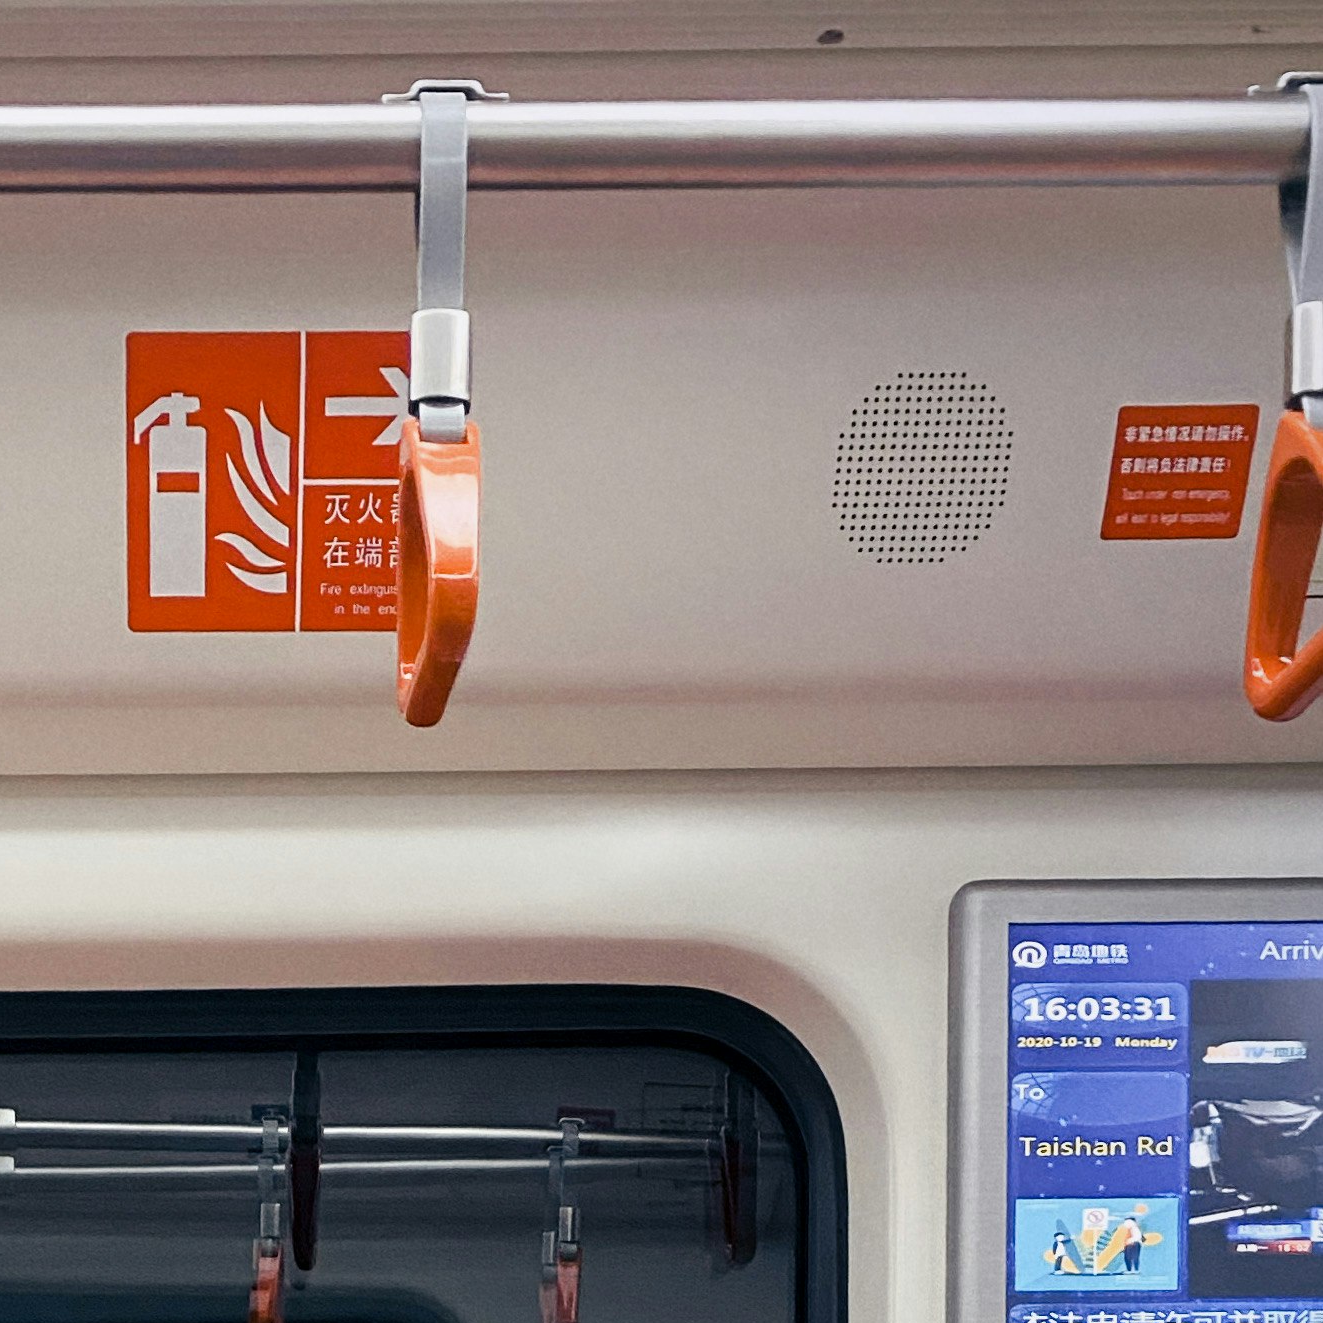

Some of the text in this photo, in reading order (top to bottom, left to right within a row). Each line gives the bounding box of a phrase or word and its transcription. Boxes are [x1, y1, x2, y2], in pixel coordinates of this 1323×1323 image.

[320, 583, 399, 597] Fire extinguis
[352, 604, 371, 615] the
[1259, 940, 1323, 961] Arriv
[1023, 996, 1177, 1022] 16:03:31
[1017, 1036, 1178, 1051] 2020-10-19 Monday
[1013, 1083, 1046, 1101] To
[1019, 1135, 1174, 1157] Taishan Rd
